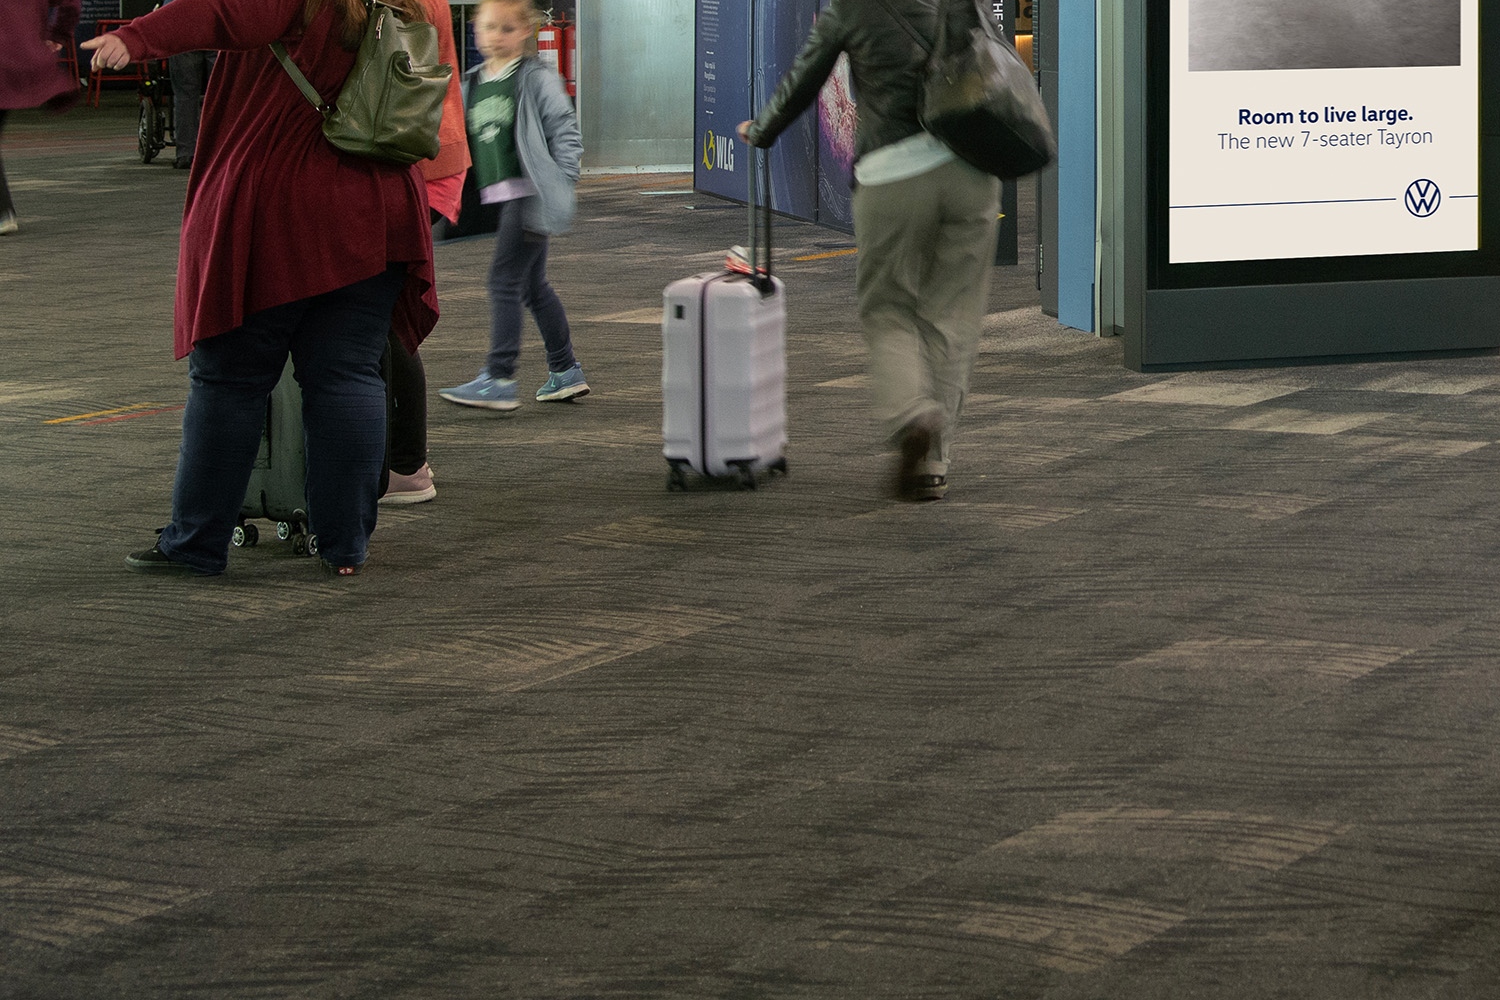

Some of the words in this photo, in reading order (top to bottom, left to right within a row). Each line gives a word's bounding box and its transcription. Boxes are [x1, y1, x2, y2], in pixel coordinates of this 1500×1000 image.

[1238, 108, 1294, 125] Room
[1299, 109, 1319, 124] to
[1324, 106, 1357, 123] live
[1361, 105, 1414, 126] large.
[1217, 132, 1251, 150] The
[1255, 133, 1295, 149] new
[1301, 130, 1373, 148] 7-seater
[1377, 128, 1433, 149] Tayron
[716, 135, 734, 172] WLG
